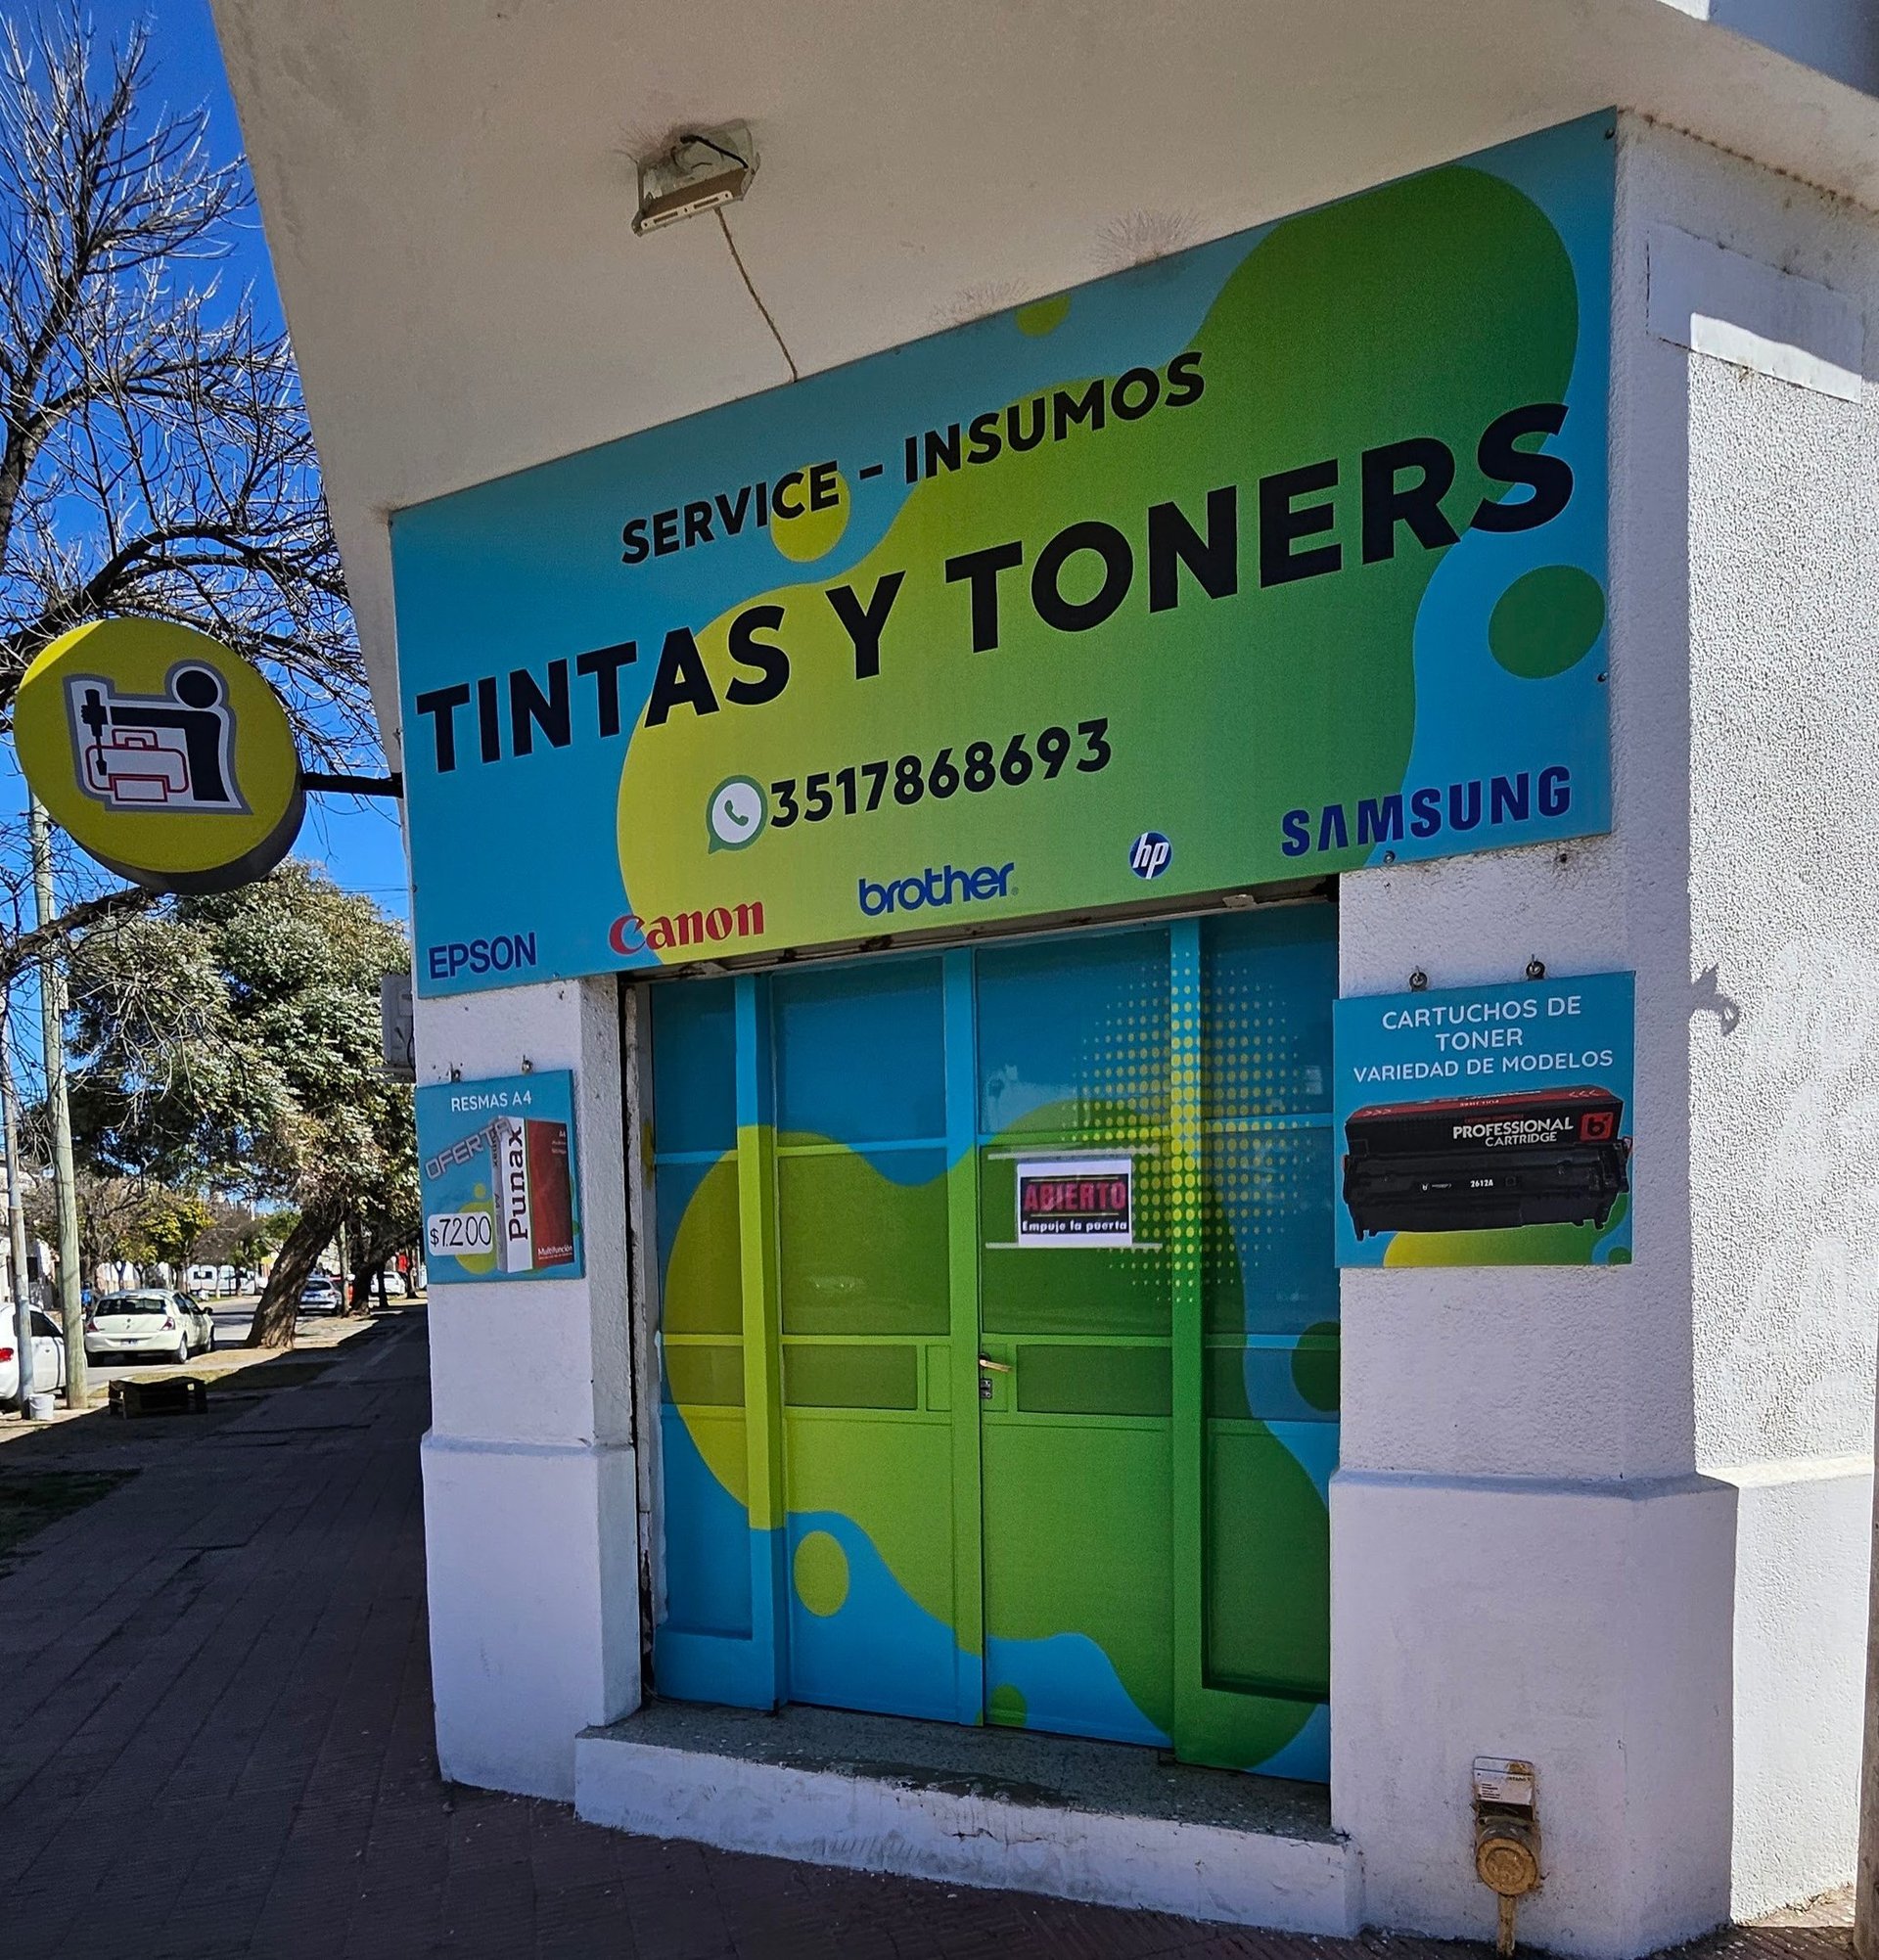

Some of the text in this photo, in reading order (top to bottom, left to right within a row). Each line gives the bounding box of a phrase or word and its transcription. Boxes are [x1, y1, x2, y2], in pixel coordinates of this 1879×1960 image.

[619, 459, 841, 566] SERVICE
[904, 350, 1206, 484] INSUMOS
[416, 402, 1575, 774] TINTAS Y TONERS
[768, 718, 1113, 830] 3517868693
[1280, 764, 1572, 858] SAMSUNG
[1131, 833, 1169, 879] hp
[858, 862, 1015, 917] brother
[609, 899, 764, 955] Canon
[428, 932, 536, 980] EPSON
[1382, 995, 1581, 1030] CARTUCHOS DE
[1435, 1027, 1524, 1053] TONER
[1353, 1050, 1614, 1083] VARIEDAD DE MODELOS
[450, 1090, 532, 1112] RESMAS A4
[425, 1117, 514, 1181] OFERTA
[1452, 1117, 1574, 1140] PROFESSIONAL
[1485, 1131, 1557, 1147] CARTRIDGE
[508, 1125, 528, 1242] Pumax
[1023, 1180, 1126, 1211] ABIERTO
[1470, 1179, 1493, 1188] 2612A
[1022, 1218, 1127, 1233] Empuje la puerta
